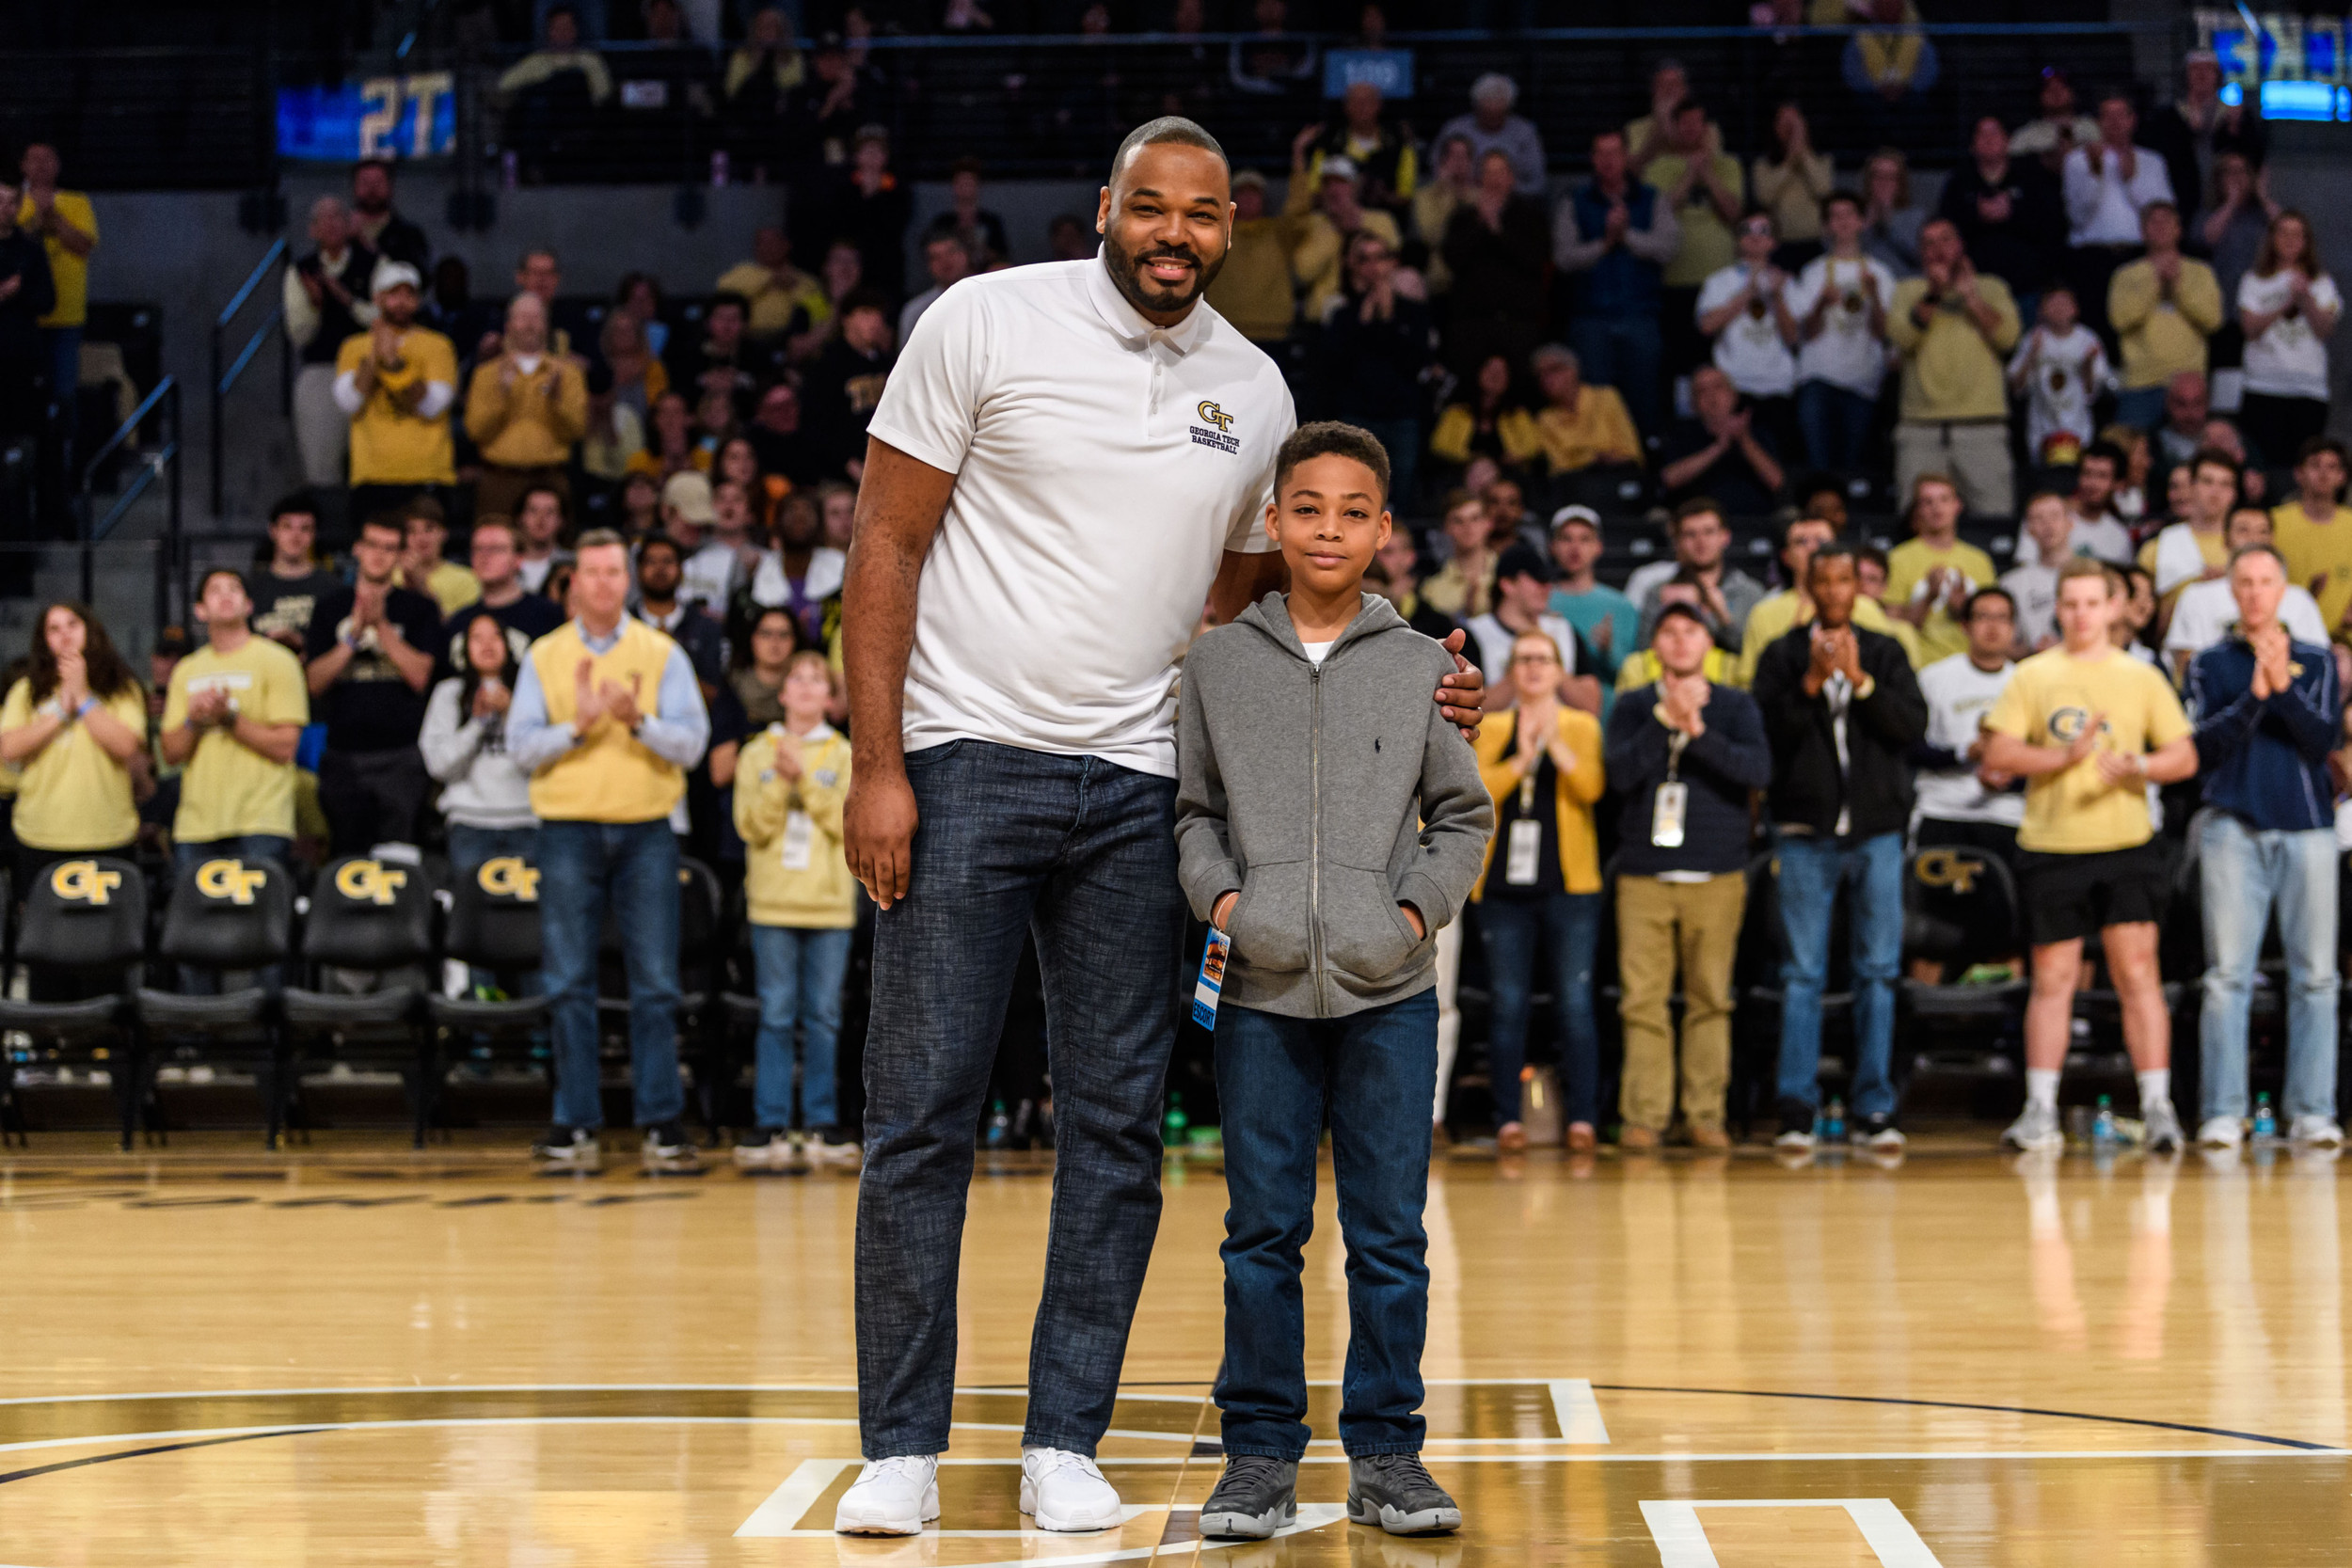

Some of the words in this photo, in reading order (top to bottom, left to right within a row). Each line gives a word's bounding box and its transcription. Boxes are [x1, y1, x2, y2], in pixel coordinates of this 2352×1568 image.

[1190, 426, 1221, 441] GEORGIA
[1222, 435, 1240, 447] TECH
[1198, 400, 1233, 433] GT
[1192, 435, 1237, 455] BASKETBALL
[51, 859, 122, 905] GT
[195, 858, 267, 905] GT
[335, 859, 407, 905] GT
[477, 856, 542, 902] GT
[1915, 848, 1985, 893] GT
[1193, 1001, 1215, 1027] ESCORT
